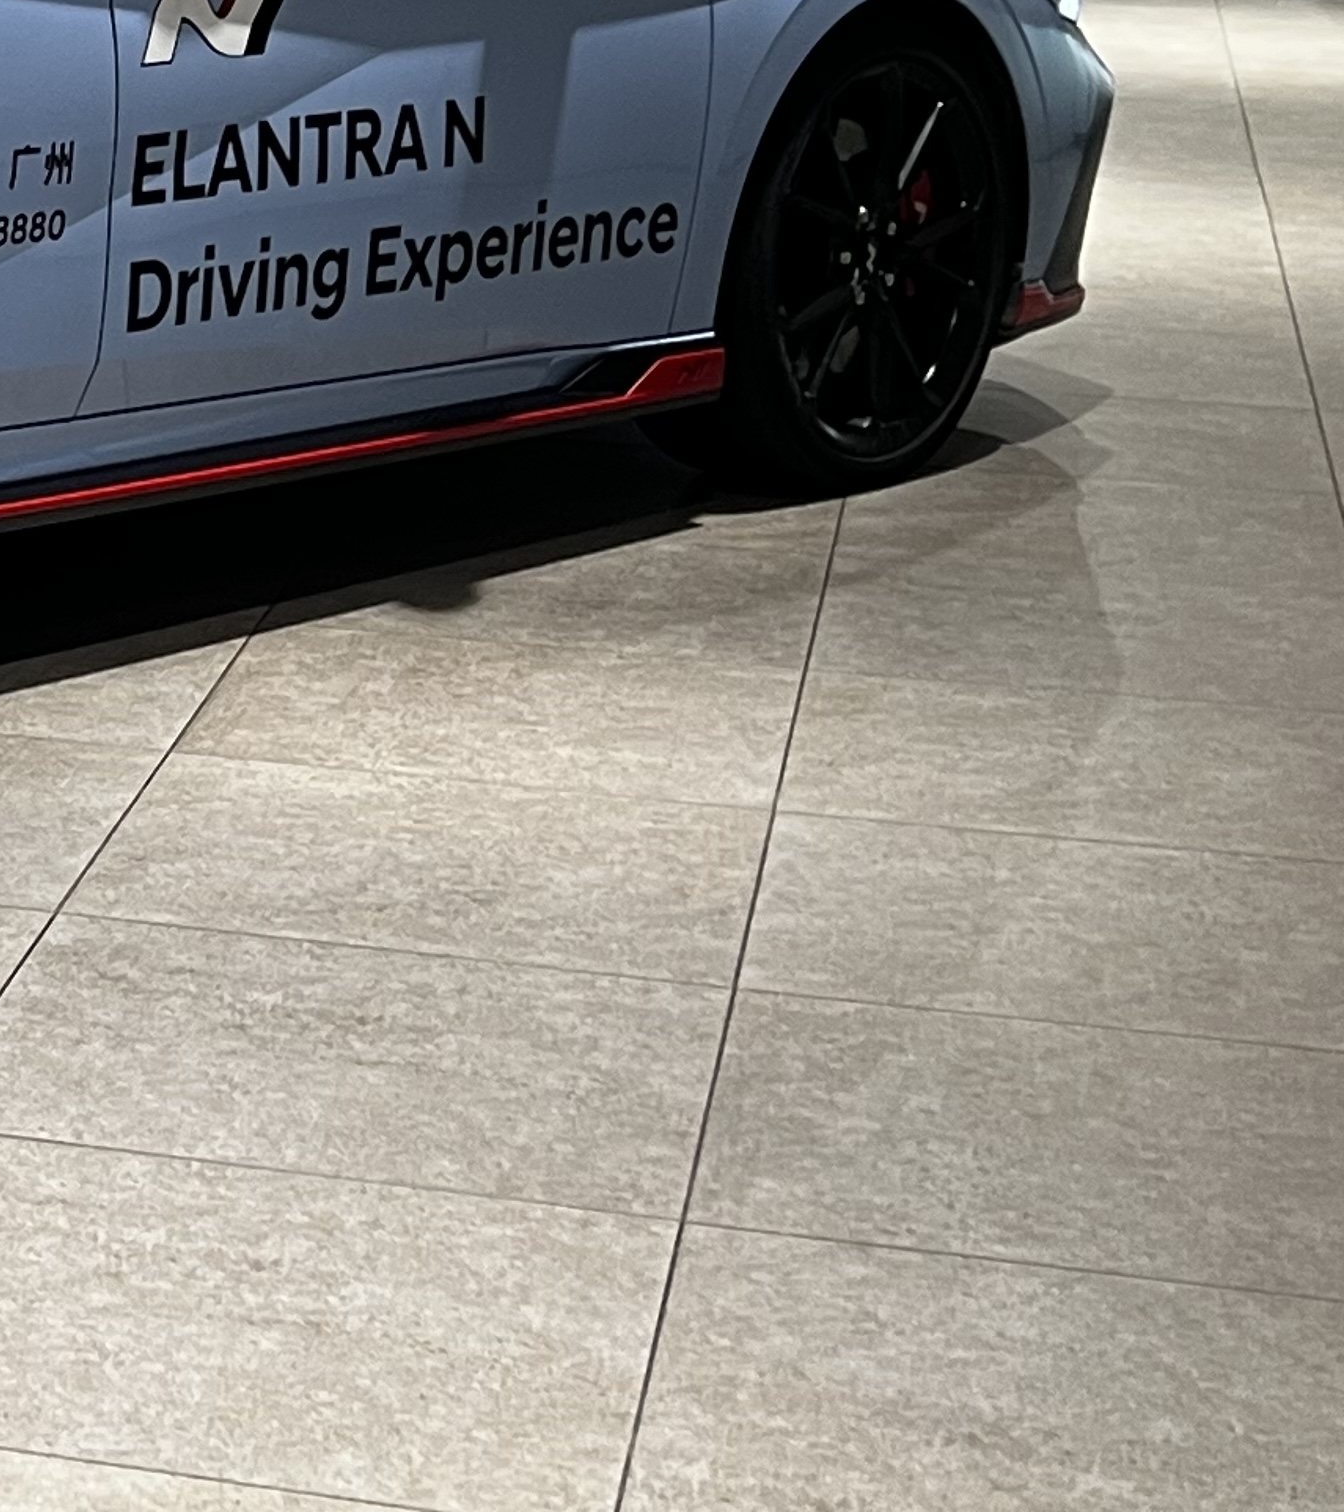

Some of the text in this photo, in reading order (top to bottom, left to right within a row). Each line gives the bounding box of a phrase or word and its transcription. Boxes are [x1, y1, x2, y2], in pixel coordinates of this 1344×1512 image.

[9, 140, 75, 190] 广州
[130, 95, 486, 207] ELANTRA N
[126, 199, 679, 333] Driving Experience
